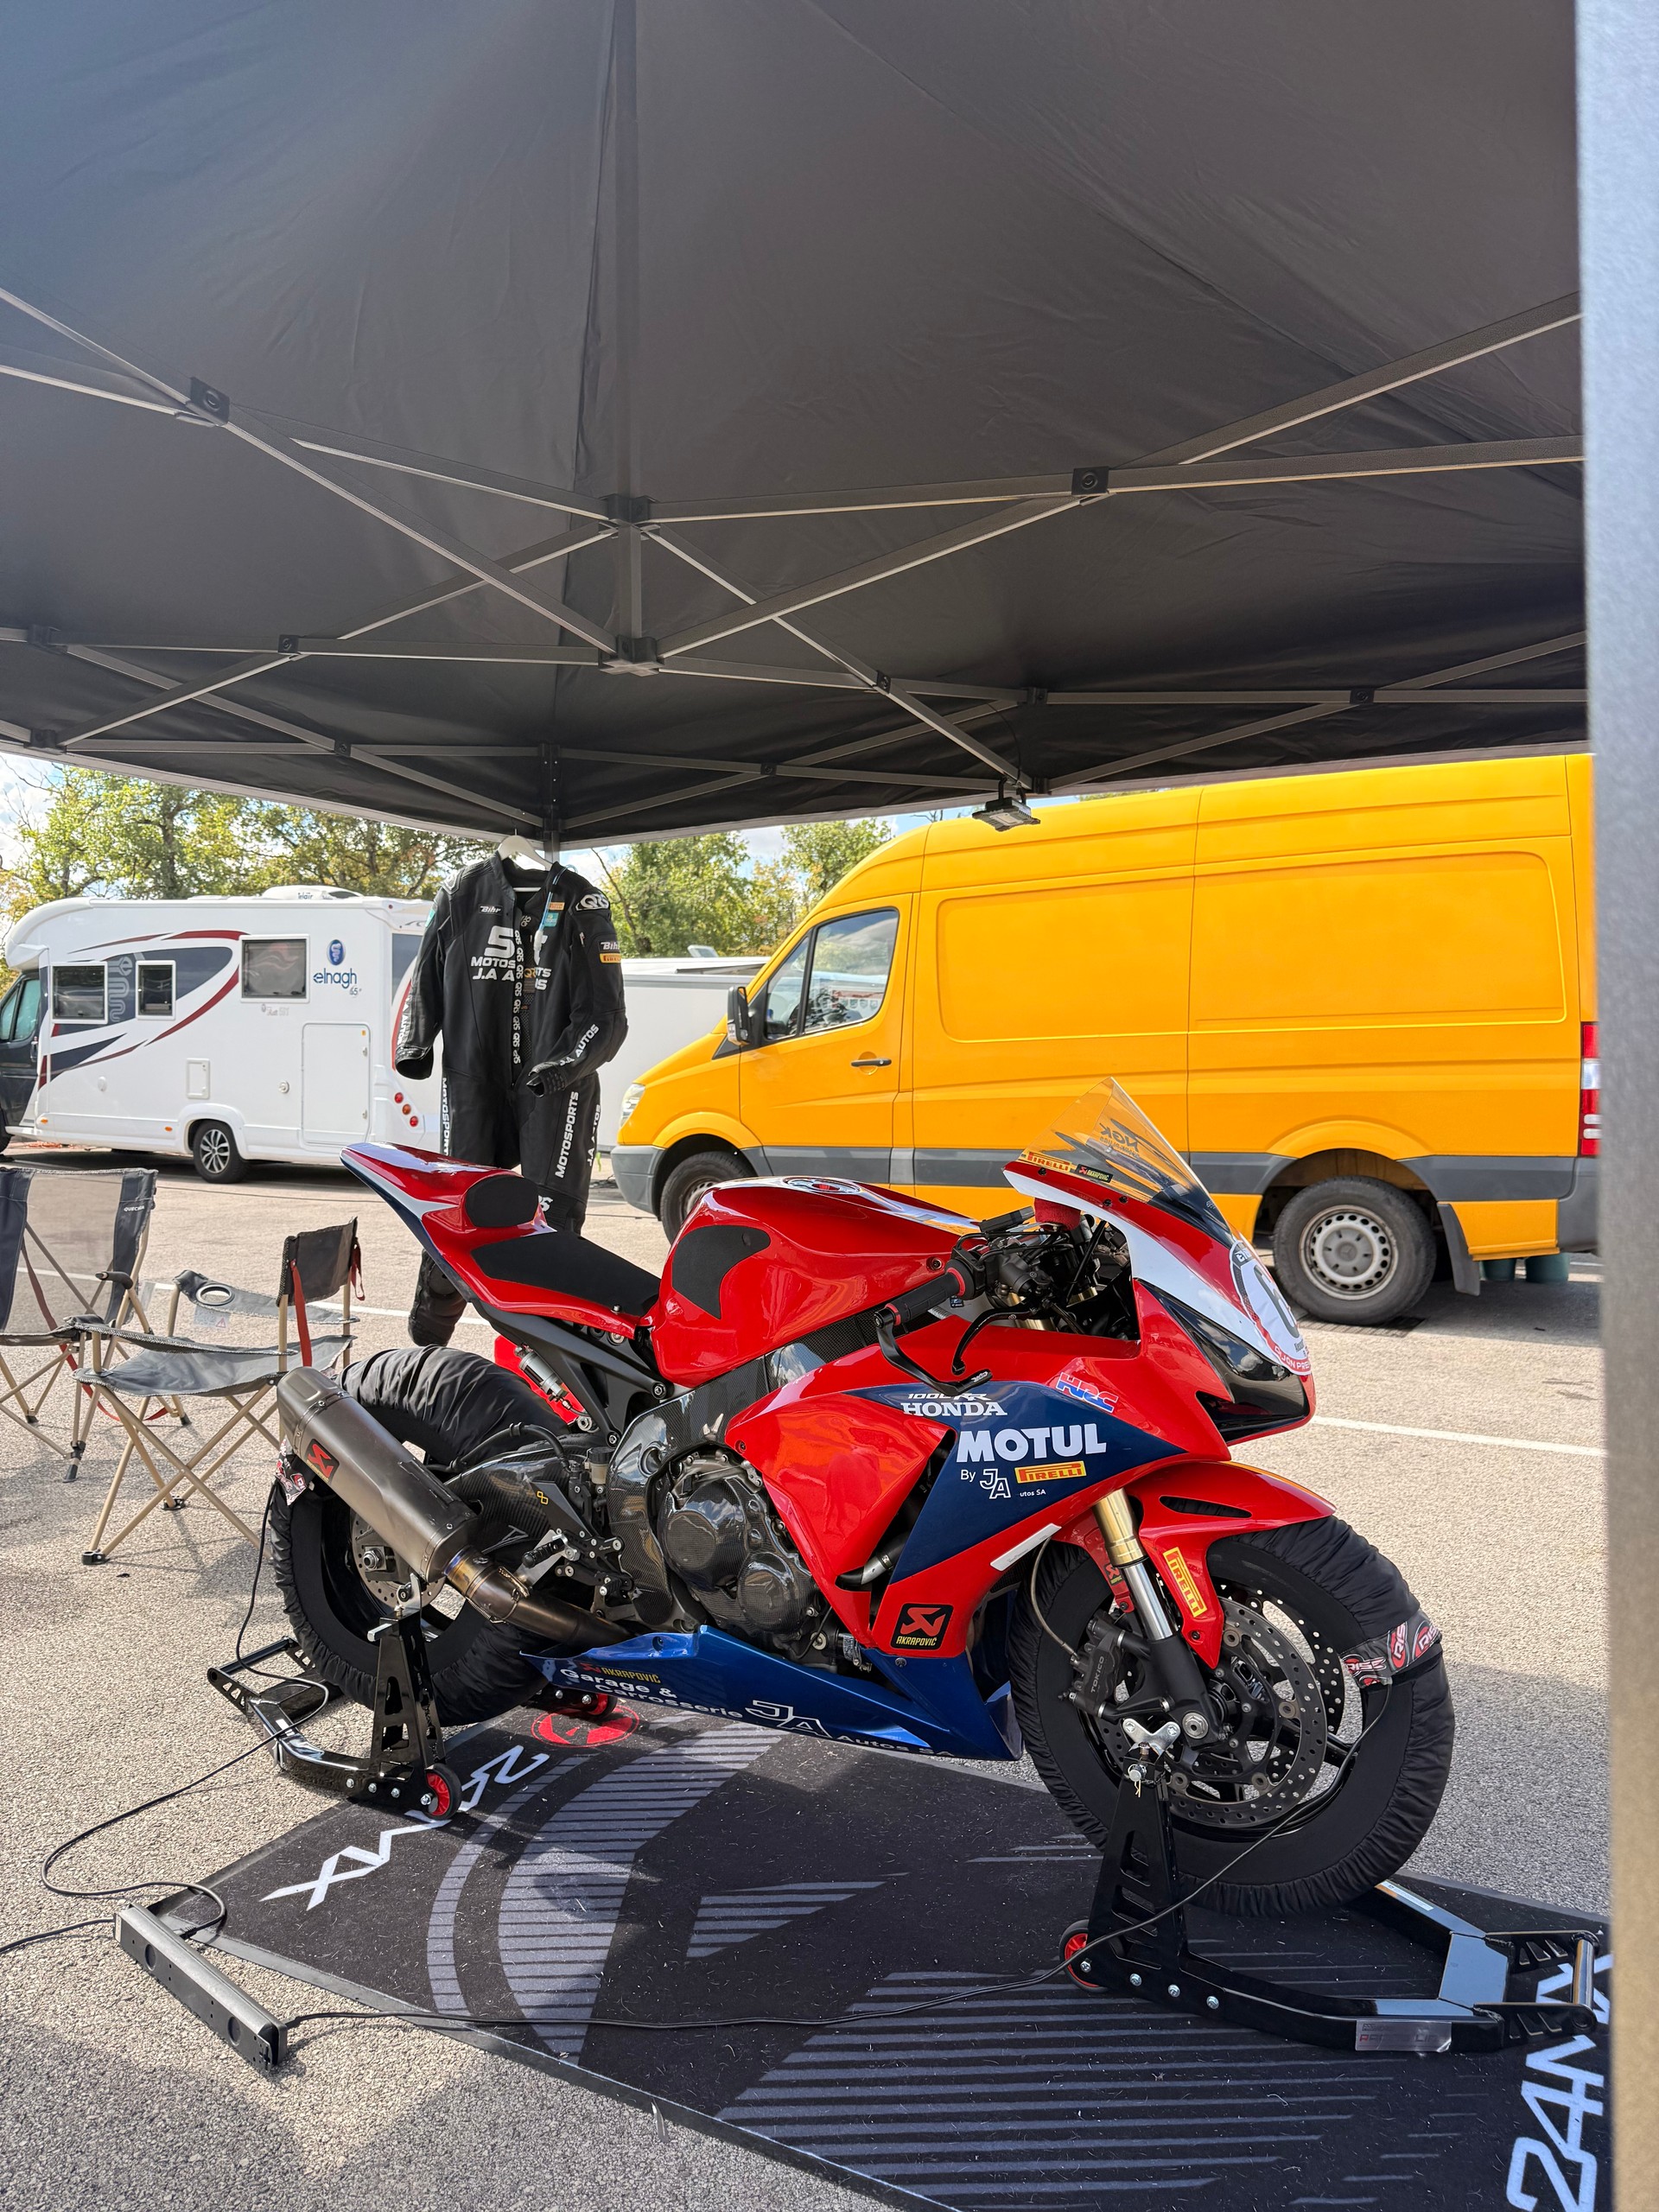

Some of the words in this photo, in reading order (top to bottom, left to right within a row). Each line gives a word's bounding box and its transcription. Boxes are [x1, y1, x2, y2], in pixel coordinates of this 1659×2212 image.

[601, 942, 620, 950] Bih
[313, 968, 357, 989] elnagh
[575, 1024, 600, 1058] AUTOS
[555, 1091, 579, 1178] MOTOSPORTS
[1027, 1152, 1070, 1172] PIRELLI
[900, 1402, 1007, 1417] HONDA
[956, 1423, 1107, 1463] MOTUL
[960, 1469, 976, 1483] By
[1019, 1464, 1083, 1482] PIRELLI
[1166, 1550, 1205, 1614] PIRELLI
[560, 1669, 650, 1693] Garage
[658, 1688, 677, 1699] &
[1090, 1655, 1105, 1694] TOKICO
